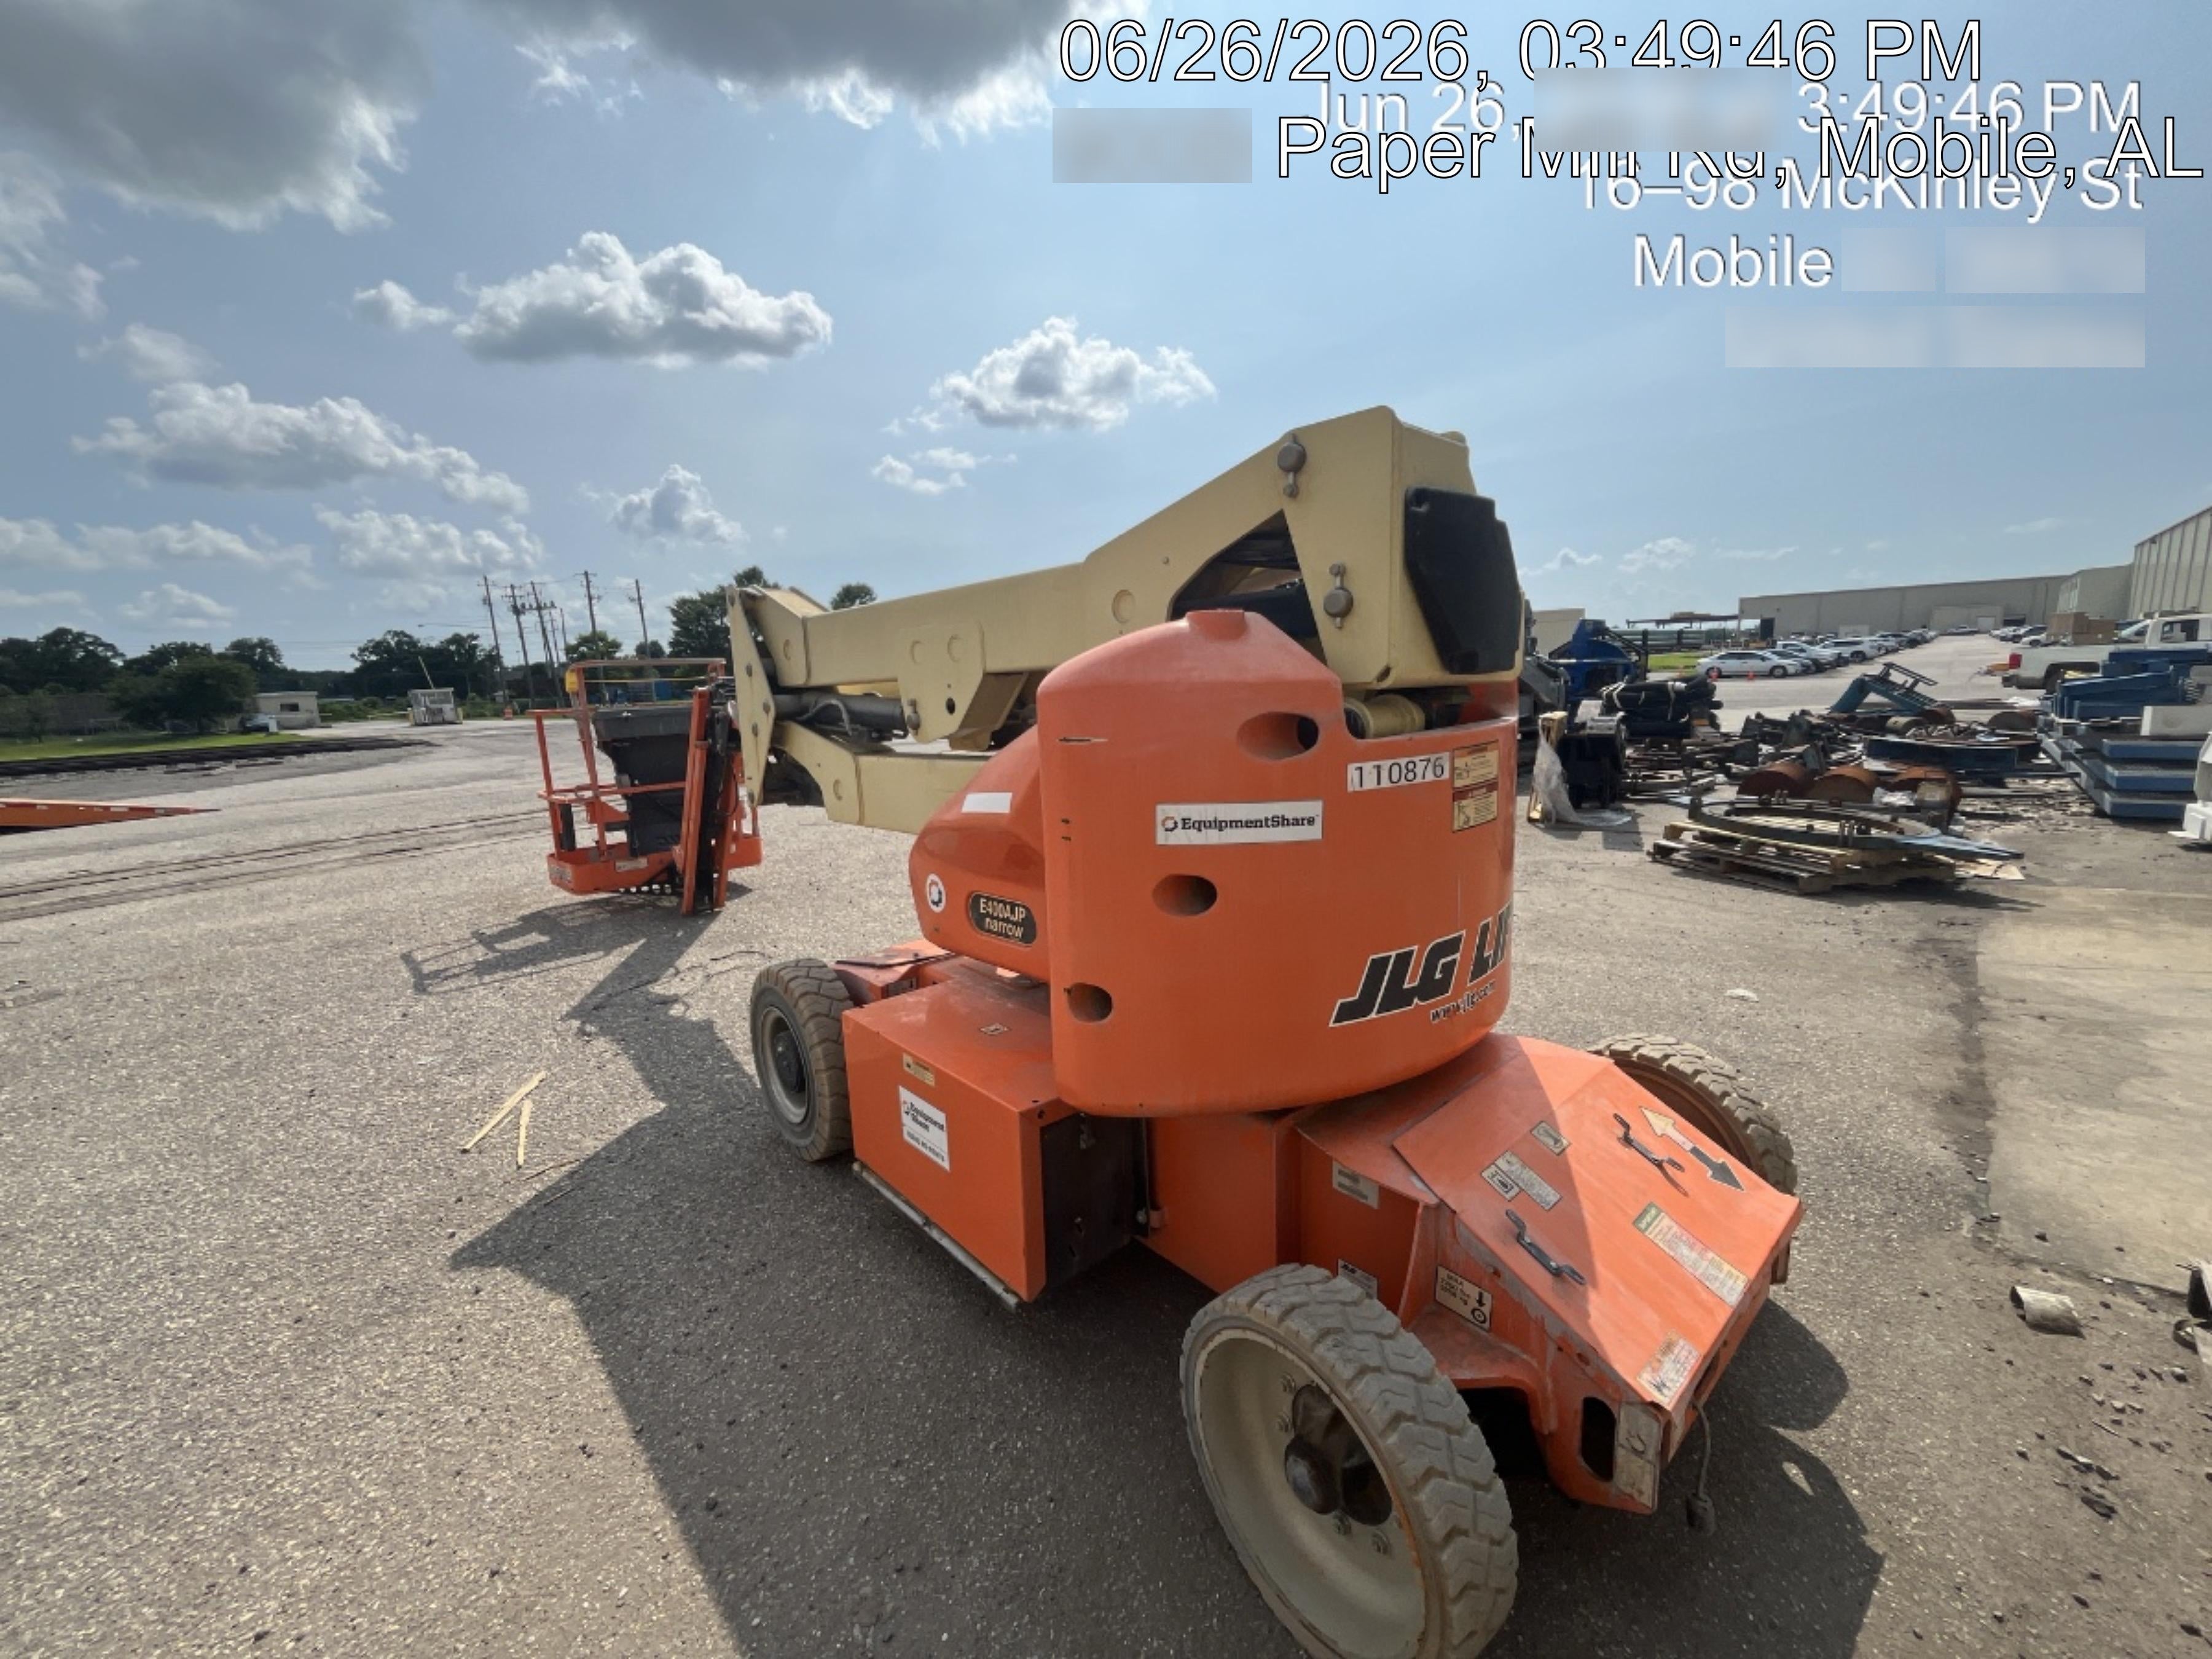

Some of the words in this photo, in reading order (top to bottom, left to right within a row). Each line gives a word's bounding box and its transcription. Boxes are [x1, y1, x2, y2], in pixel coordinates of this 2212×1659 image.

[1354, 758, 1445, 788] 110876
[1181, 814, 1316, 832] EquipmentShare
[986, 918, 1024, 938] narrow
[1329, 930, 1466, 1027] JLG
